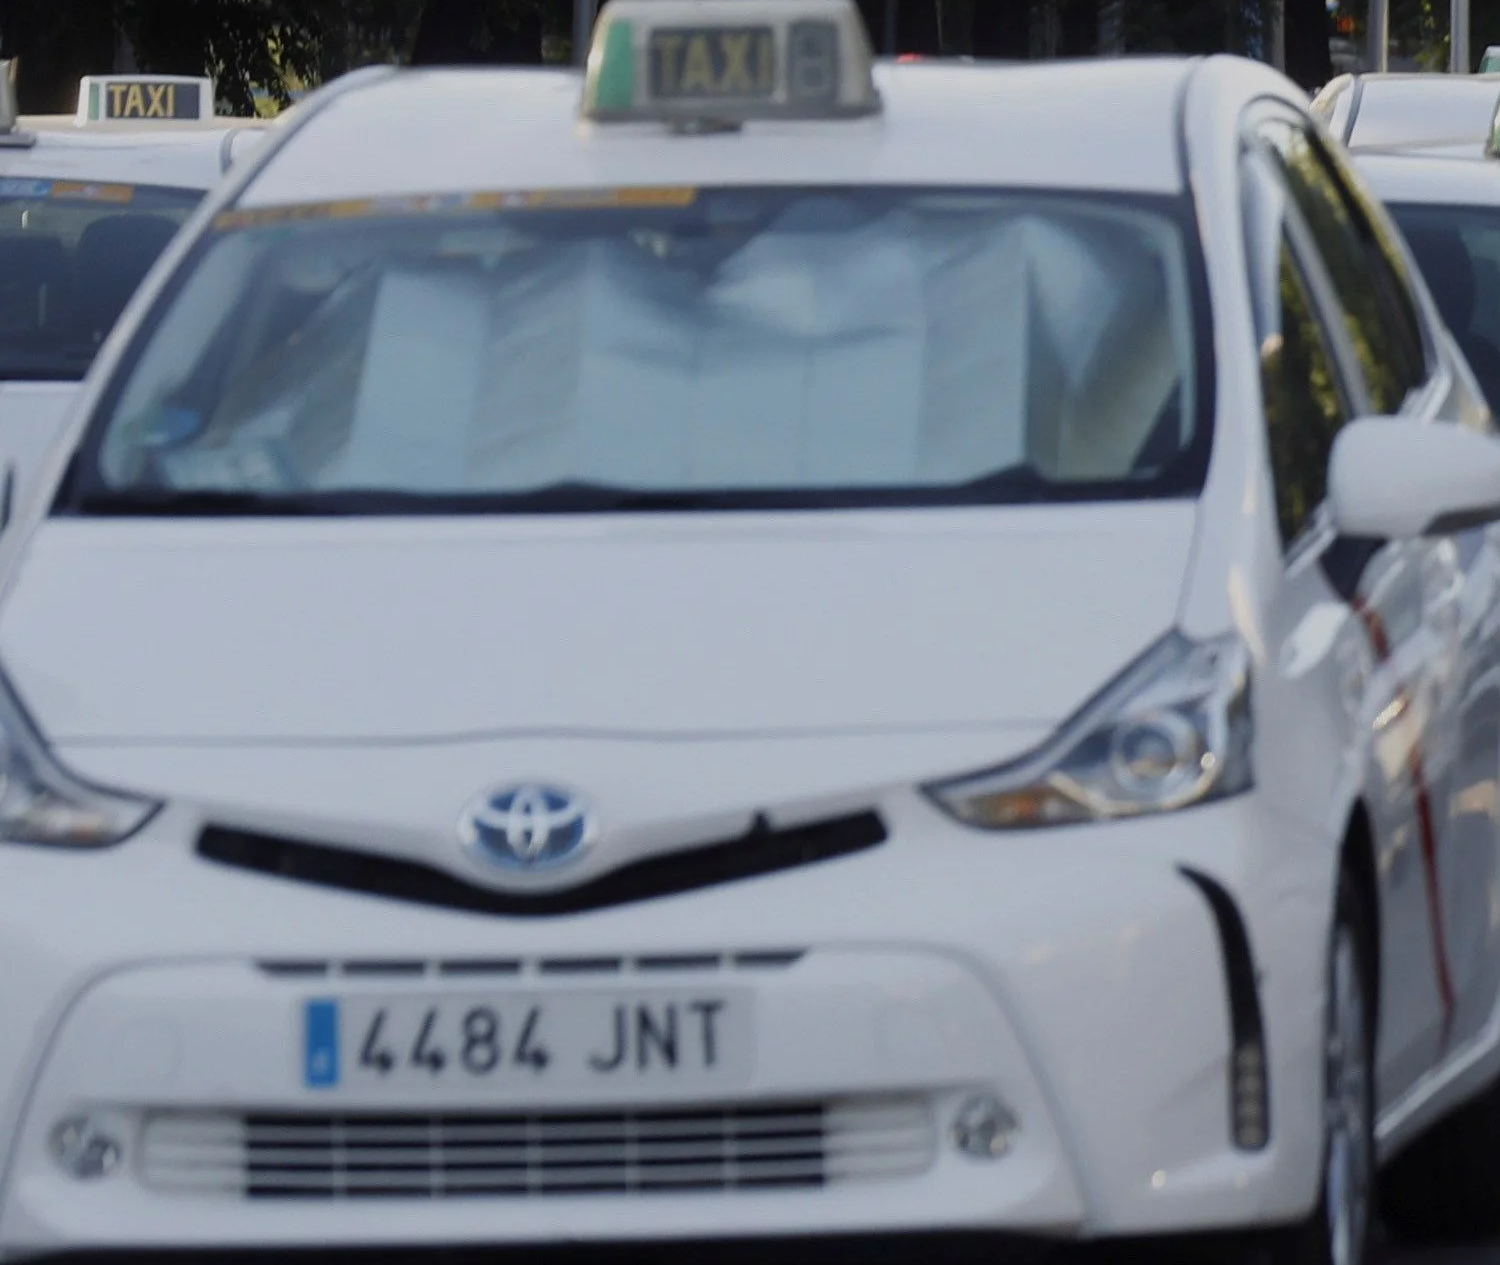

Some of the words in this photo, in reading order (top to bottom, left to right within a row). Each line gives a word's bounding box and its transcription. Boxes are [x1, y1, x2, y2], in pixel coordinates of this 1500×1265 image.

[655, 35, 773, 93] TAXI
[109, 85, 176, 117] TAXI
[359, 1004, 550, 1074] 4484
[587, 1001, 727, 1074] JNT
